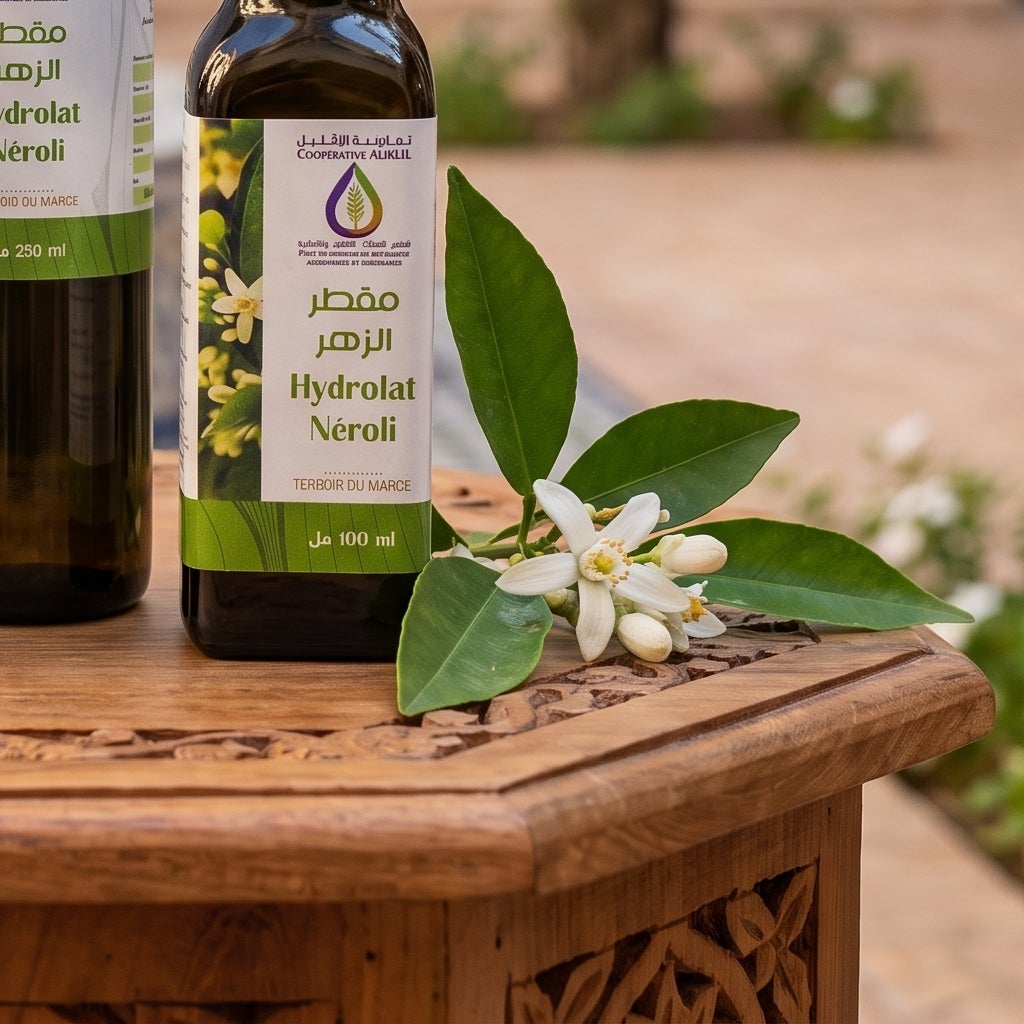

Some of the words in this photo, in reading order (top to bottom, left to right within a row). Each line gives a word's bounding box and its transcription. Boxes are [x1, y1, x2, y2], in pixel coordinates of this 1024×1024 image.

[41, 196, 79, 207] MARCE
[48, 242, 66, 258] ml
[308, 287, 400, 319] مقطر
[316, 328, 392, 360] الزهر
[291, 374, 417, 407] Hydrolat
[311, 416, 396, 443] Néroli
[348, 480, 365, 492] DU
[369, 480, 412, 492] MARCE
[338, 531, 369, 547] 100
[375, 531, 395, 547] ml
